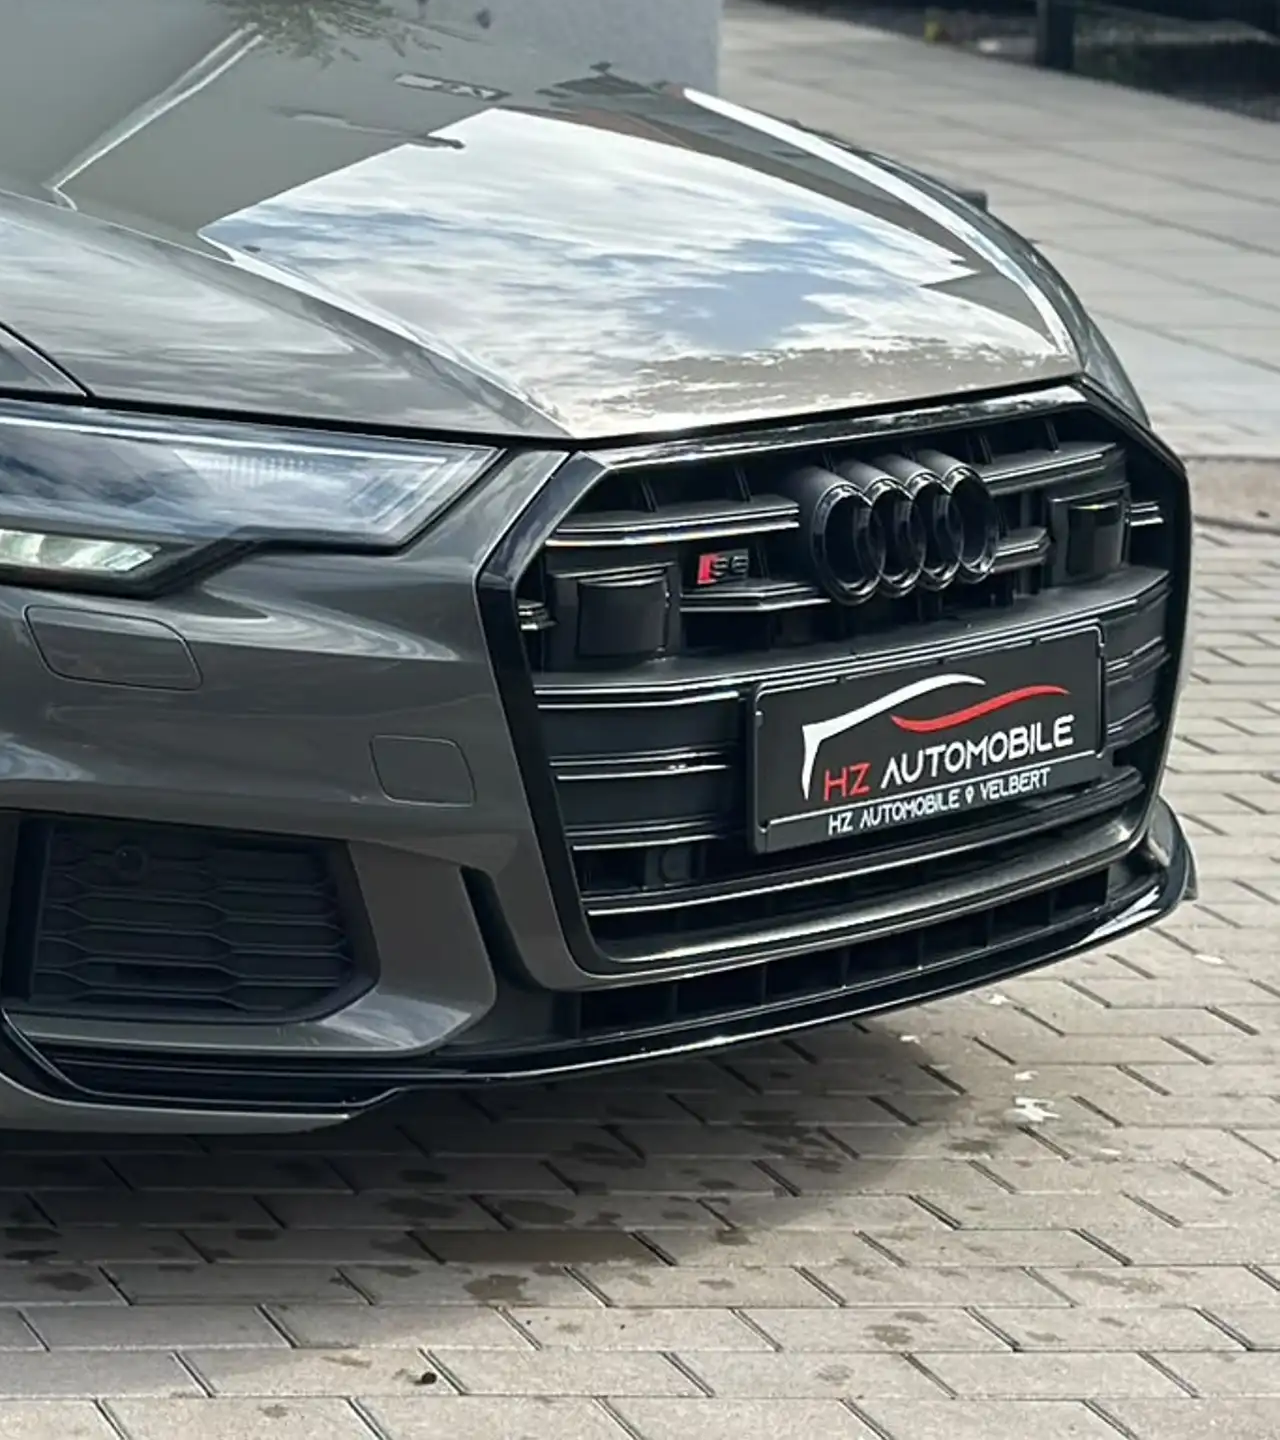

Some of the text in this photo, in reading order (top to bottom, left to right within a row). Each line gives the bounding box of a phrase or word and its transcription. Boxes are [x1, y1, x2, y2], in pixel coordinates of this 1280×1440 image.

[823, 713, 1076, 802] HZ AUTOMOBILE
[828, 766, 1051, 836] HZ AUTOMOBILE VELBERT
